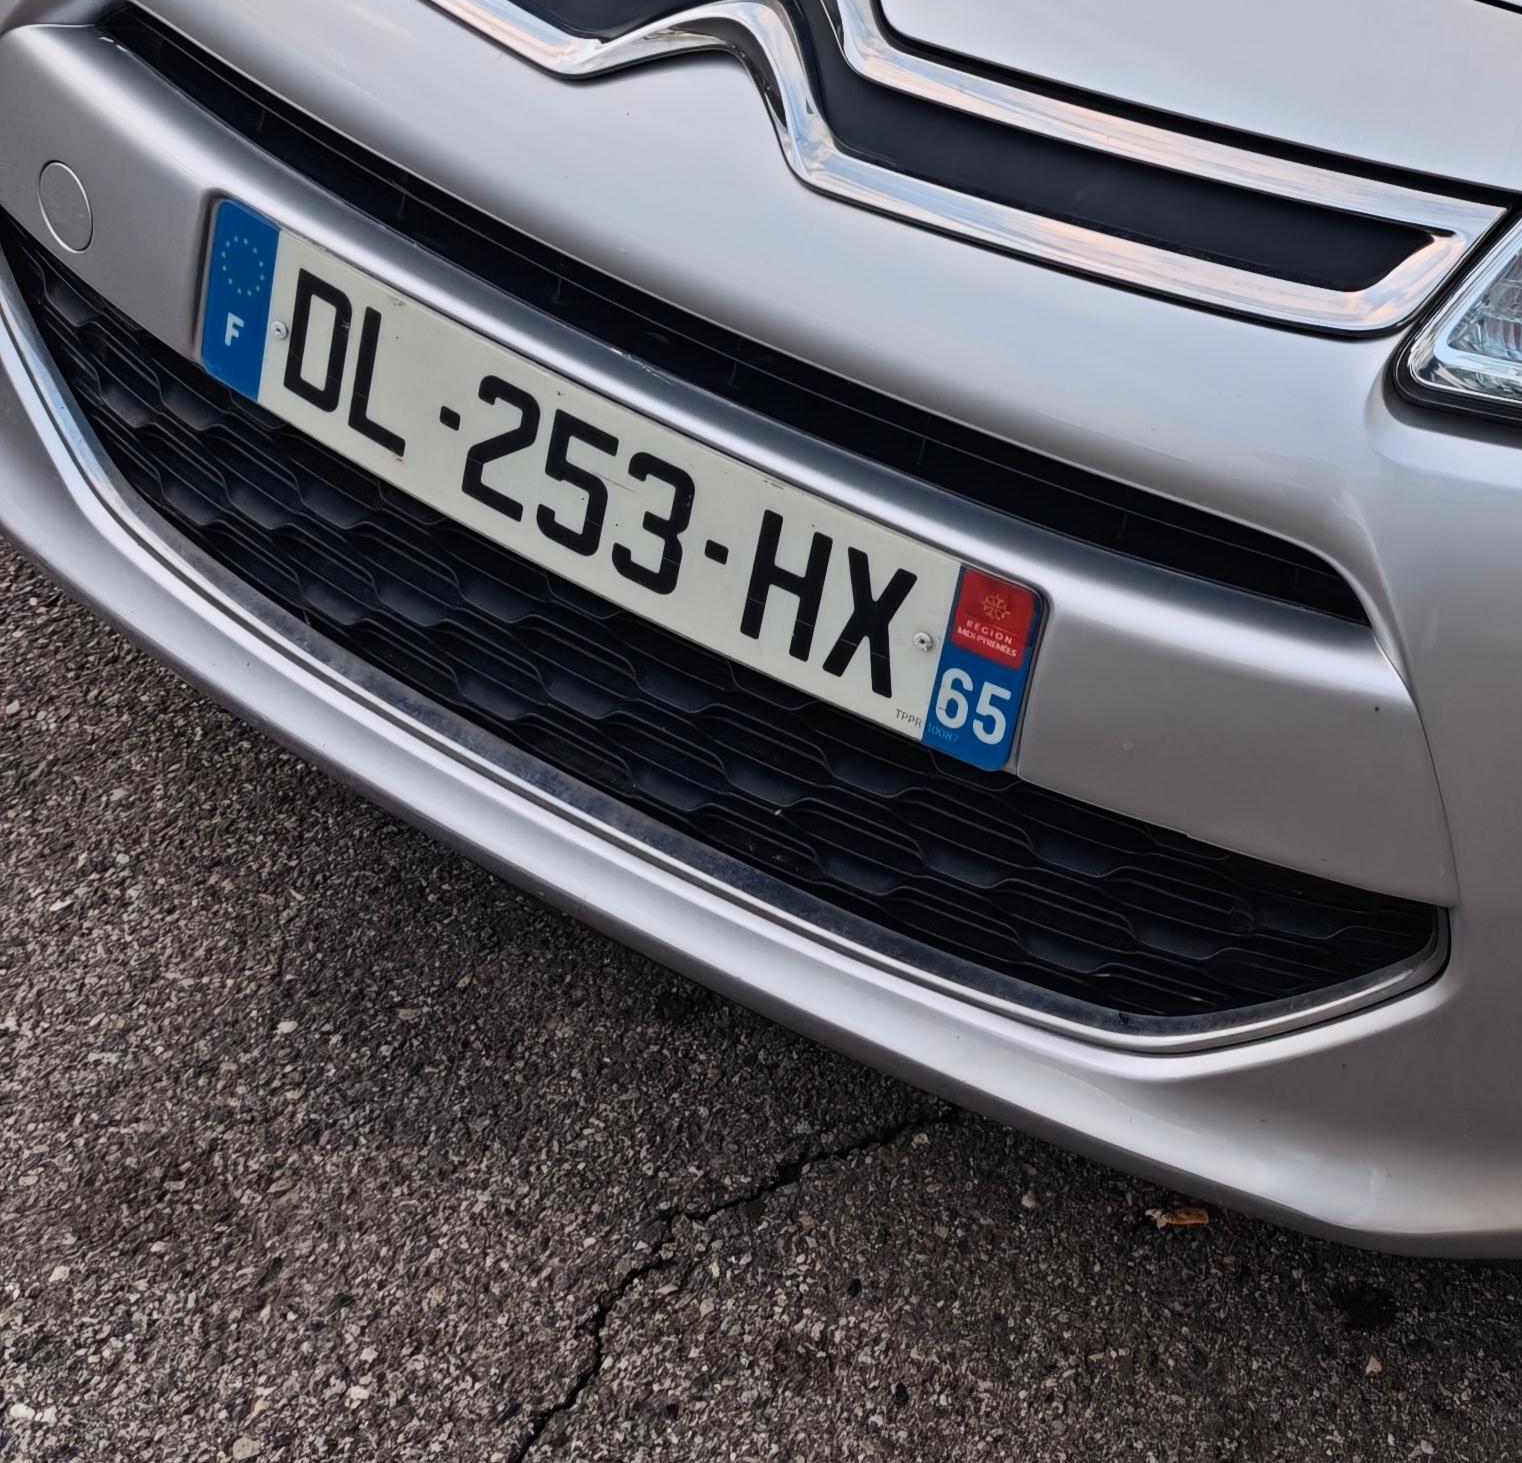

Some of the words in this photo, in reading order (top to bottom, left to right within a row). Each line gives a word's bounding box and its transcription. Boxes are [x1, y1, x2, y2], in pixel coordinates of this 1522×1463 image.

[225, 312, 245, 346] F
[283, 268, 918, 699] DL-253-HX
[896, 708, 922, 728] TPPR
[935, 668, 1012, 745] 65
